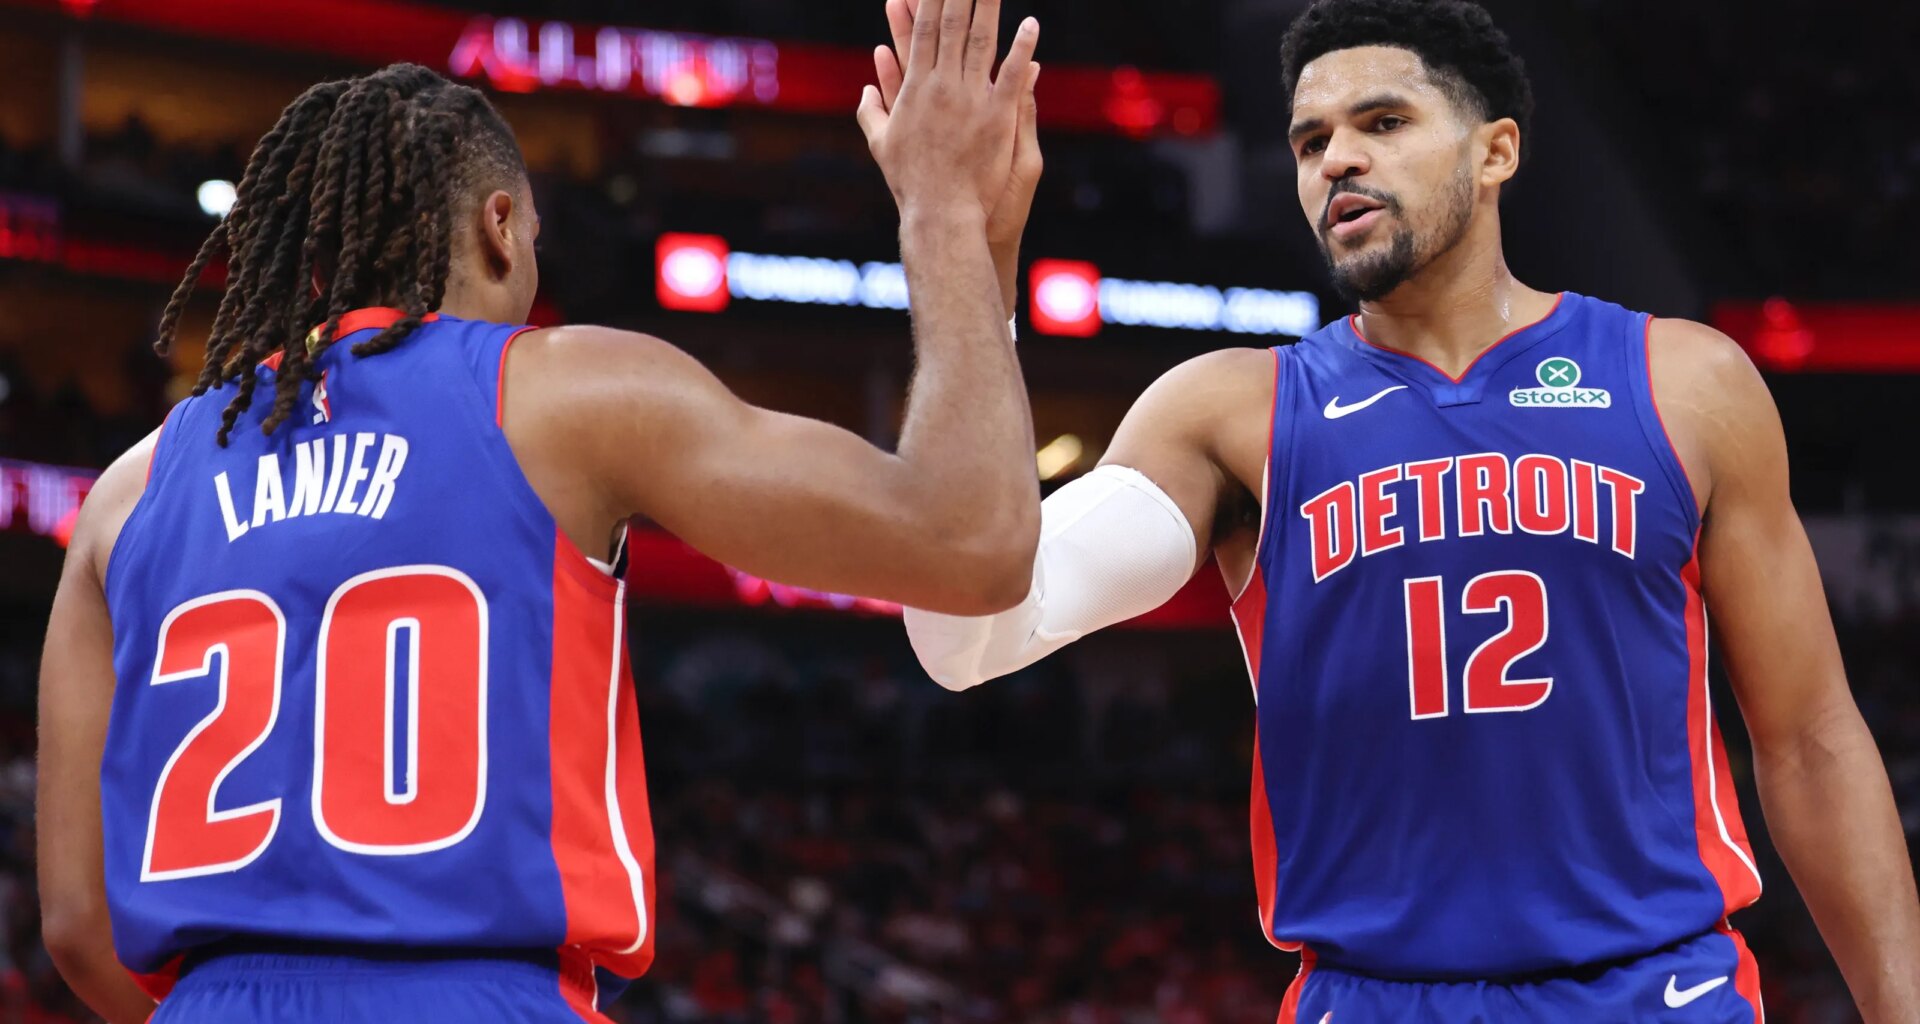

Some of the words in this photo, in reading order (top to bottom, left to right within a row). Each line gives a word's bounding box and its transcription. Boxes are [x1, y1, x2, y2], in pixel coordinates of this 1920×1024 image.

[214, 431, 408, 543] LANIER
[1300, 452, 1645, 583] DETROIT
[1403, 570, 1553, 720] 12
[140, 565, 488, 883] 20
